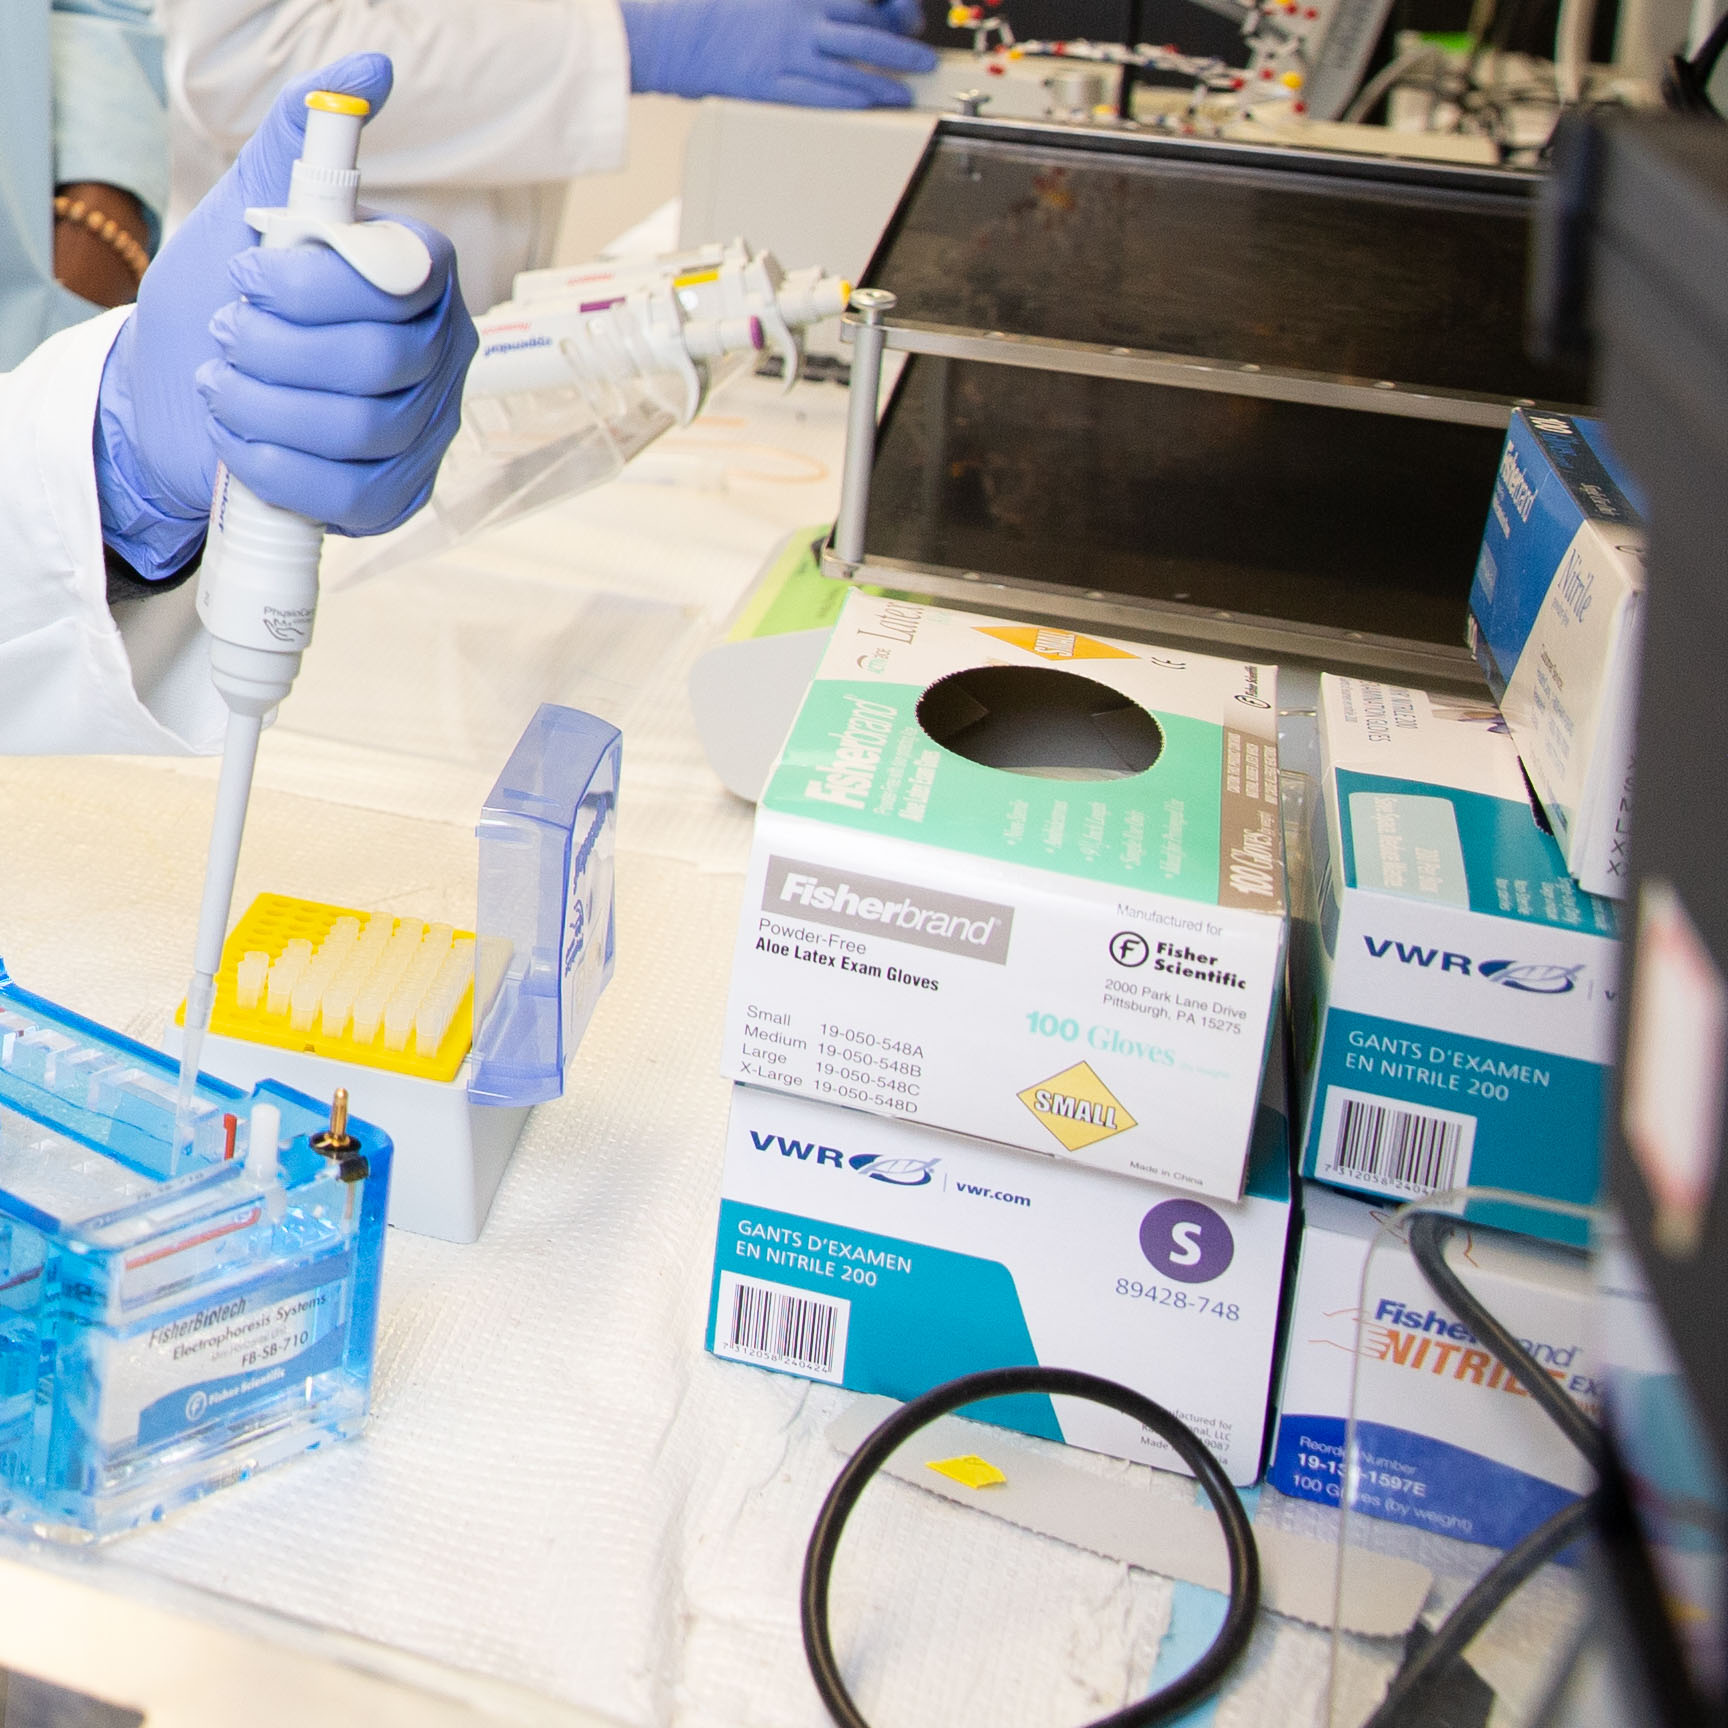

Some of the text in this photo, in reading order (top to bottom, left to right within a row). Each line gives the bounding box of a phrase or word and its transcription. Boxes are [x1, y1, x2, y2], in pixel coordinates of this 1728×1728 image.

[1557, 548, 1594, 623] Nitrile
[857, 601, 925, 645] Latex
[804, 694, 898, 810] Fisherbrand
[1229, 864, 1275, 897] 100
[780, 872, 996, 946] Fisherbrand
[1115, 903, 1223, 937] Manufactured for
[758, 918, 867, 955] Powder-Free
[1156, 942, 1219, 966] Fisher
[1363, 935, 1472, 976] VWR
[755, 937, 939, 992] Aloe Latex Exam Gloves
[1154, 958, 1247, 990] Scientific
[1103, 994, 1242, 1035] Pittsburgh, PA 15275
[1104, 978, 1247, 1020] 2000 Park Lane Drive
[744, 1024, 922, 1078] Medium 19-050-548B
[746, 1004, 924, 1059] Small 19-050-548A
[1026, 1010, 1176, 1067] 100 Gloves
[742, 1043, 920, 1097] Large 19-050-548C
[1345, 1052, 1509, 1101] EN NITRILE 200
[1348, 1030, 1551, 1087] GANTS D'EXAMEN
[740, 1061, 918, 1114] X-Large 19-050-548D
[1034, 1089, 1118, 1130] SMALL
[749, 1130, 844, 1169] VWR
[955, 1180, 1031, 1207] vwr.com
[1129, 1160, 1204, 1186] Made in China
[736, 1240, 878, 1287] EN NITRILE 200
[738, 1219, 912, 1273] GANTS D'EXAMEN
[1169, 1221, 1202, 1266] S
[1115, 1278, 1240, 1321] 89428-748
[148, 1297, 246, 1349] FisherBiotech
[172, 1293, 326, 1360] Electrophoresis Systems
[241, 1330, 309, 1368] FB-SB-710
[208, 1385, 241, 1406] Fisher
[1140, 1435, 1169, 1449] Made
[1293, 1474, 1322, 1492] 100
